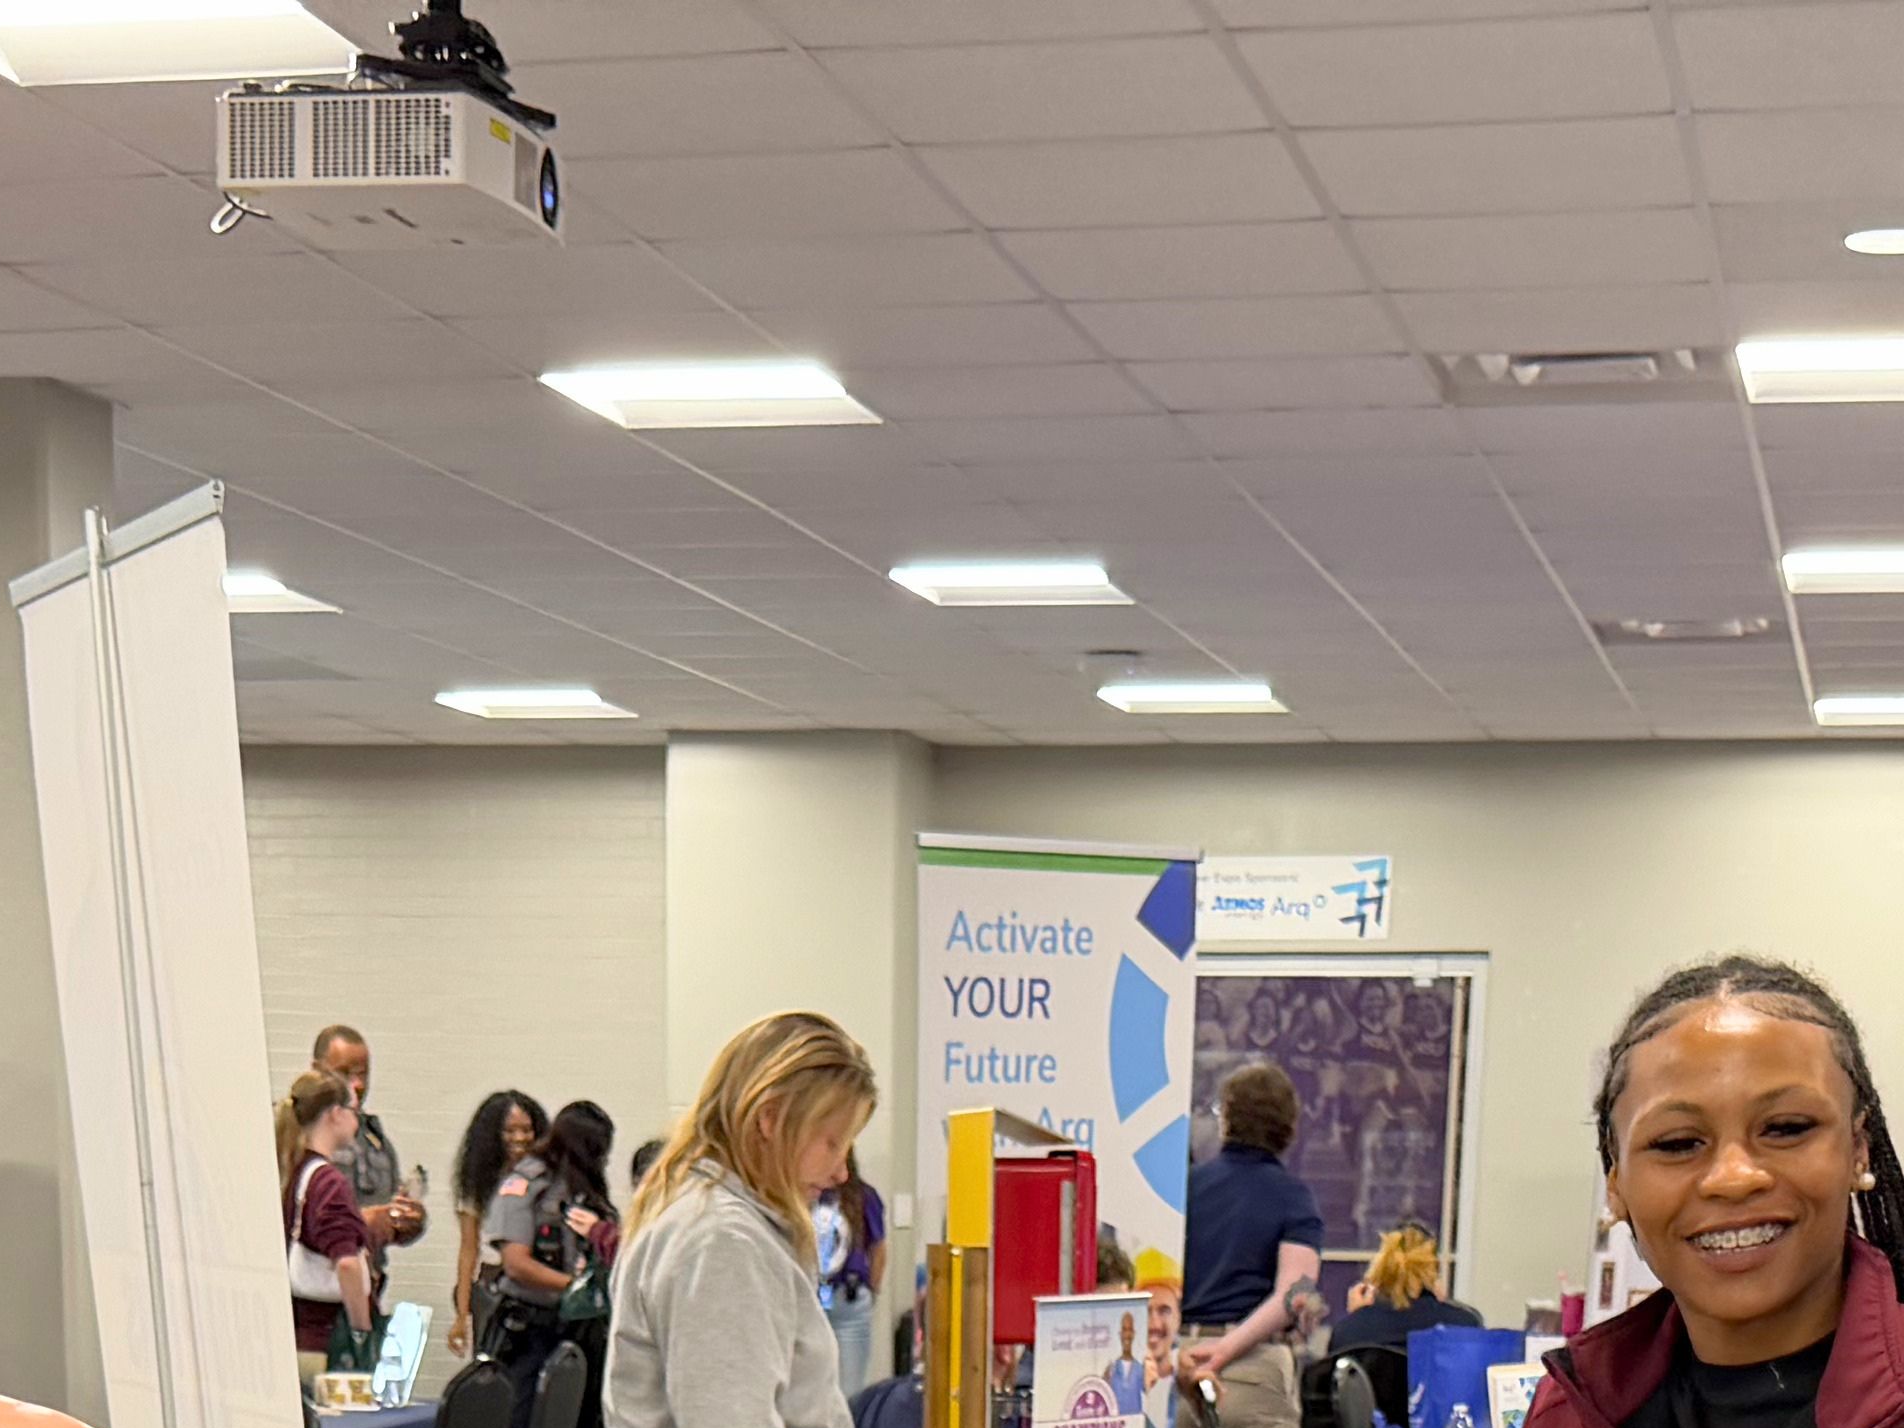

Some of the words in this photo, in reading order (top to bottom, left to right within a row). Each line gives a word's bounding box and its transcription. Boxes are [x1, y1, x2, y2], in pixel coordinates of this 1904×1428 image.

[946, 910, 1093, 955] Activate
[944, 976, 1051, 1019] YOUR
[945, 1042, 1057, 1084] Future
